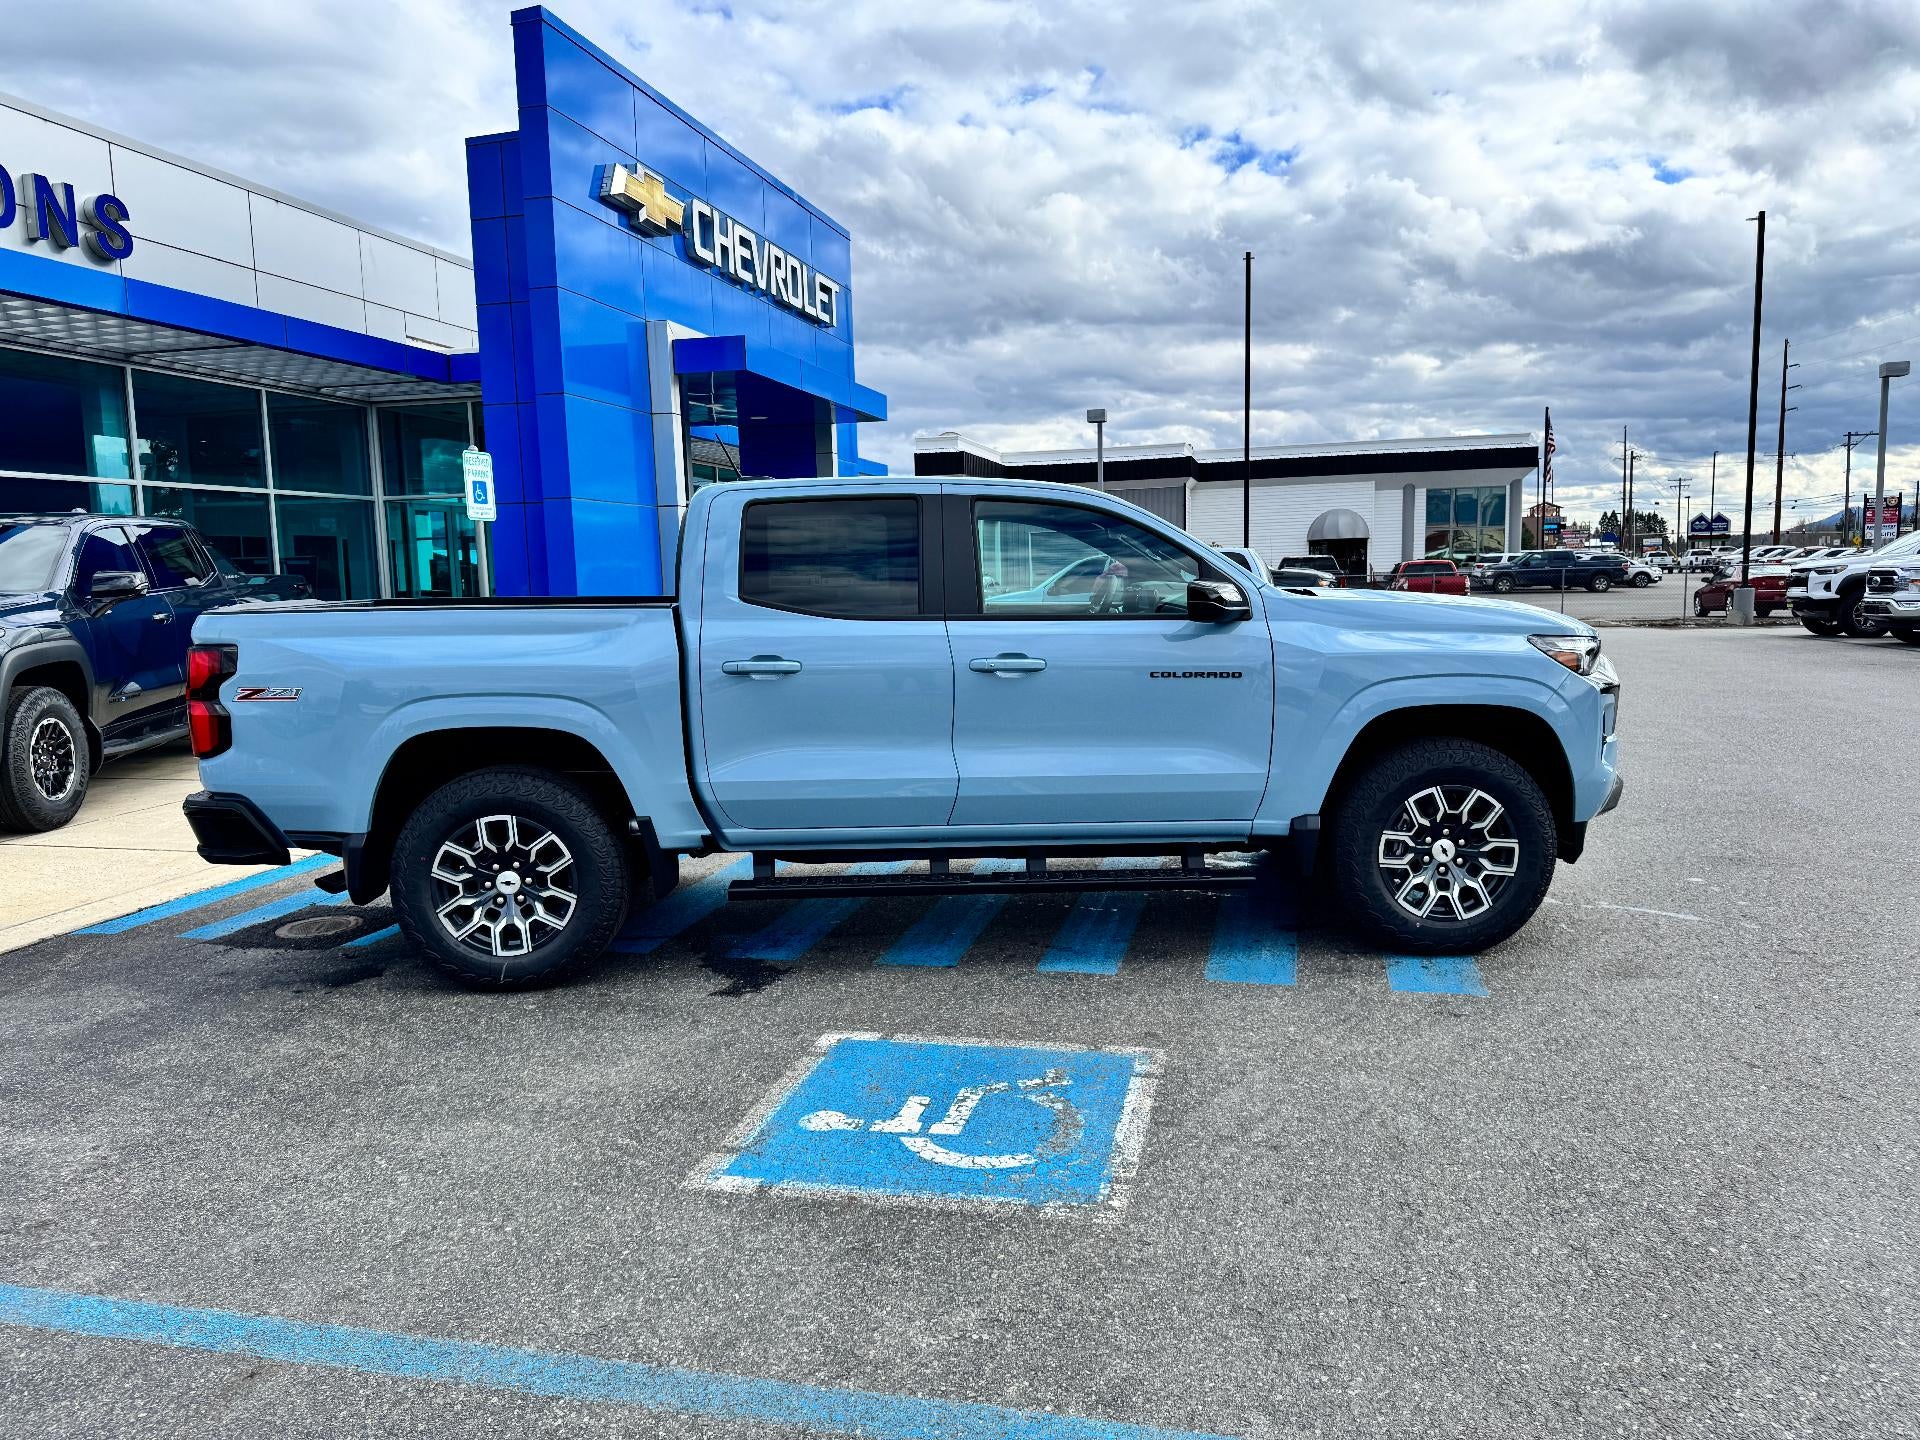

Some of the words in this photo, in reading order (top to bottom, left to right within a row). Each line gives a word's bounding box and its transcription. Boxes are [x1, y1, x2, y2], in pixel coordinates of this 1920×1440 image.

[690, 198, 840, 328] CHEVROLET
[1149, 671, 1243, 679] COLORADO
[232, 687, 303, 702] Z71
